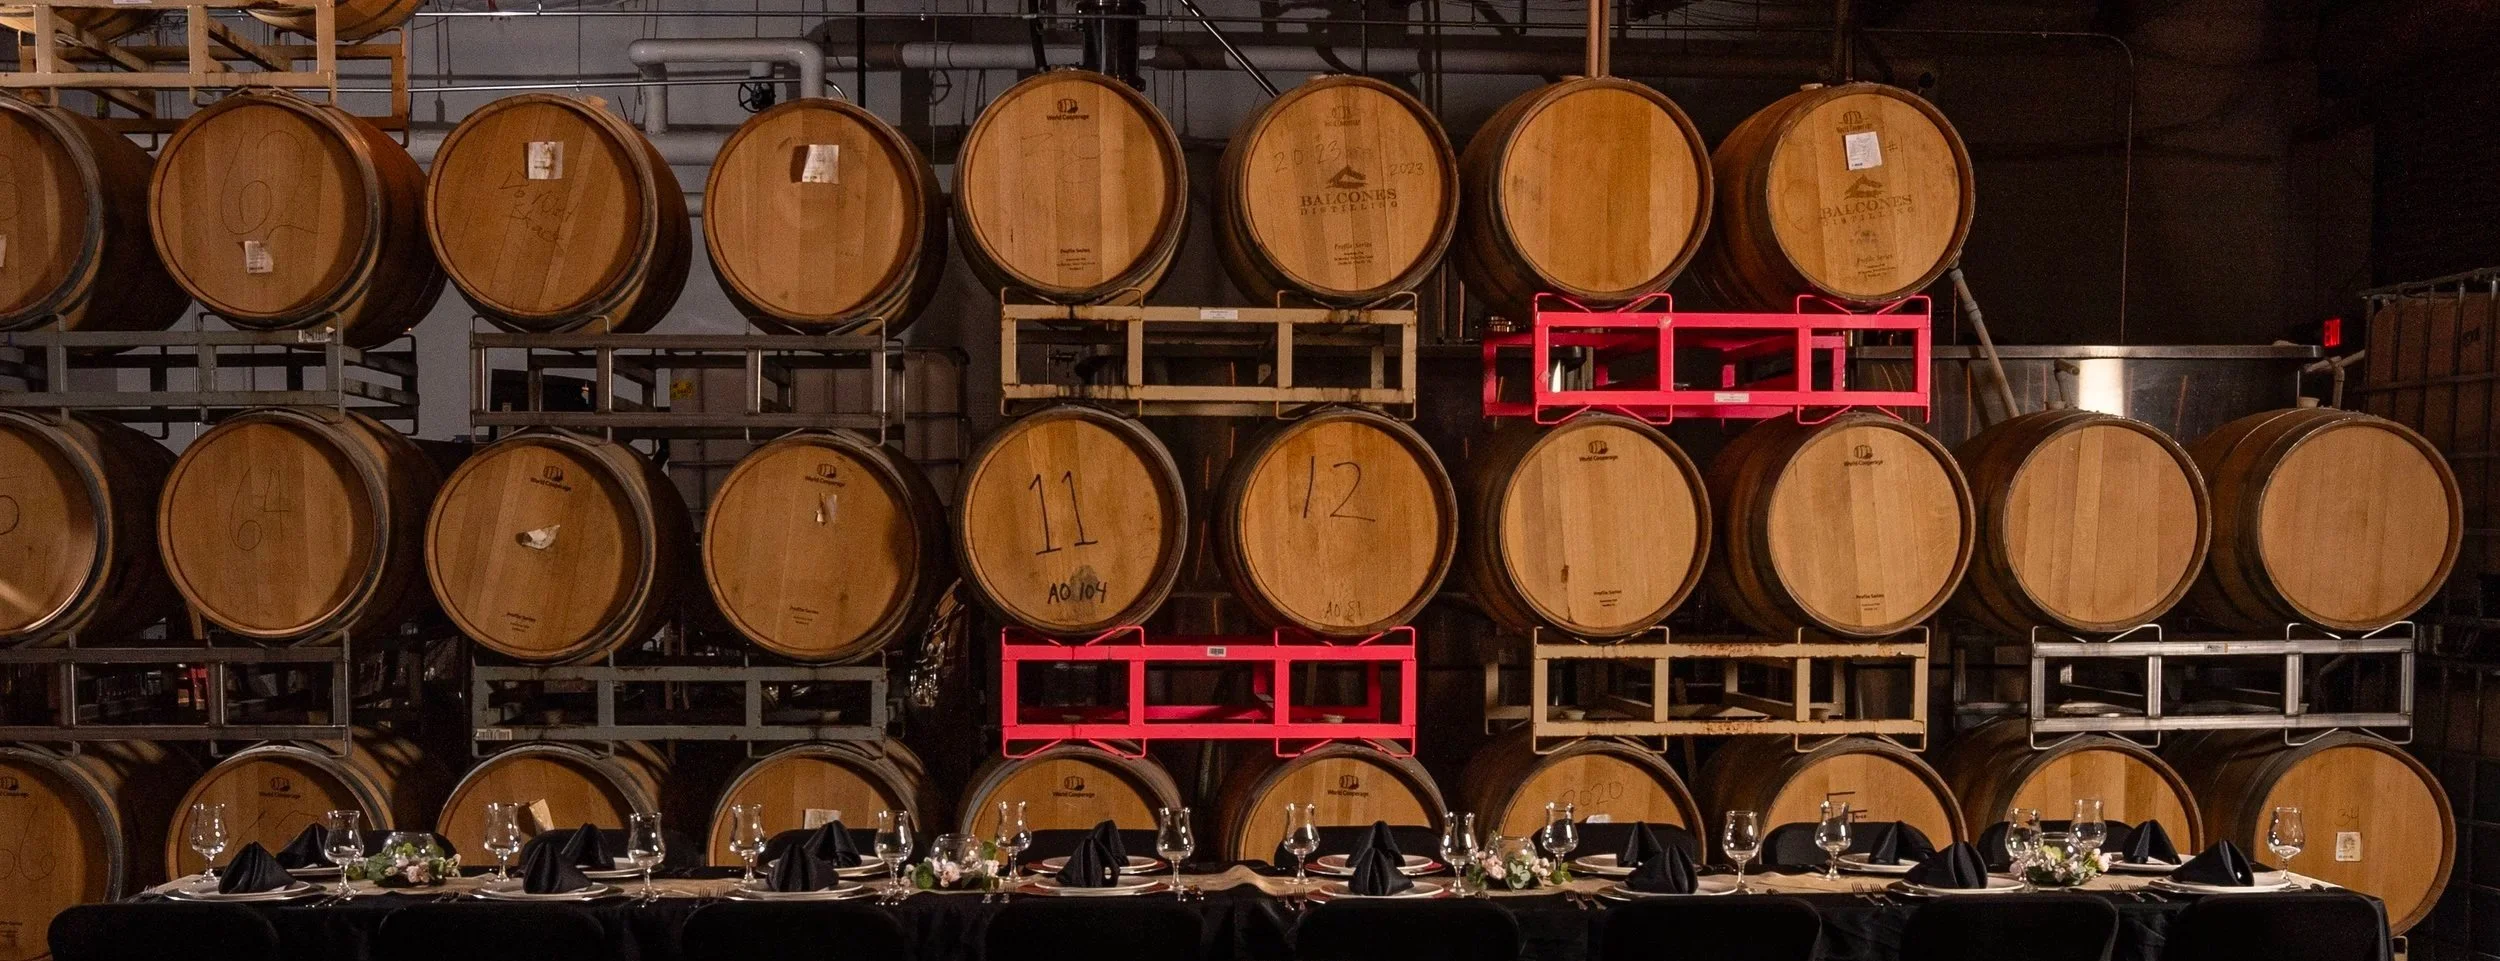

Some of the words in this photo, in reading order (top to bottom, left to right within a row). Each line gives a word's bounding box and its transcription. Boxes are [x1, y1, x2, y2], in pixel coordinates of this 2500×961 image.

[1299, 188, 1398, 208] BALCONES
[1820, 194, 1913, 220] BALCONES
[1303, 456, 1376, 523] 12
[1029, 470, 1098, 556] 11
[1080, 581, 1108, 604] 104
